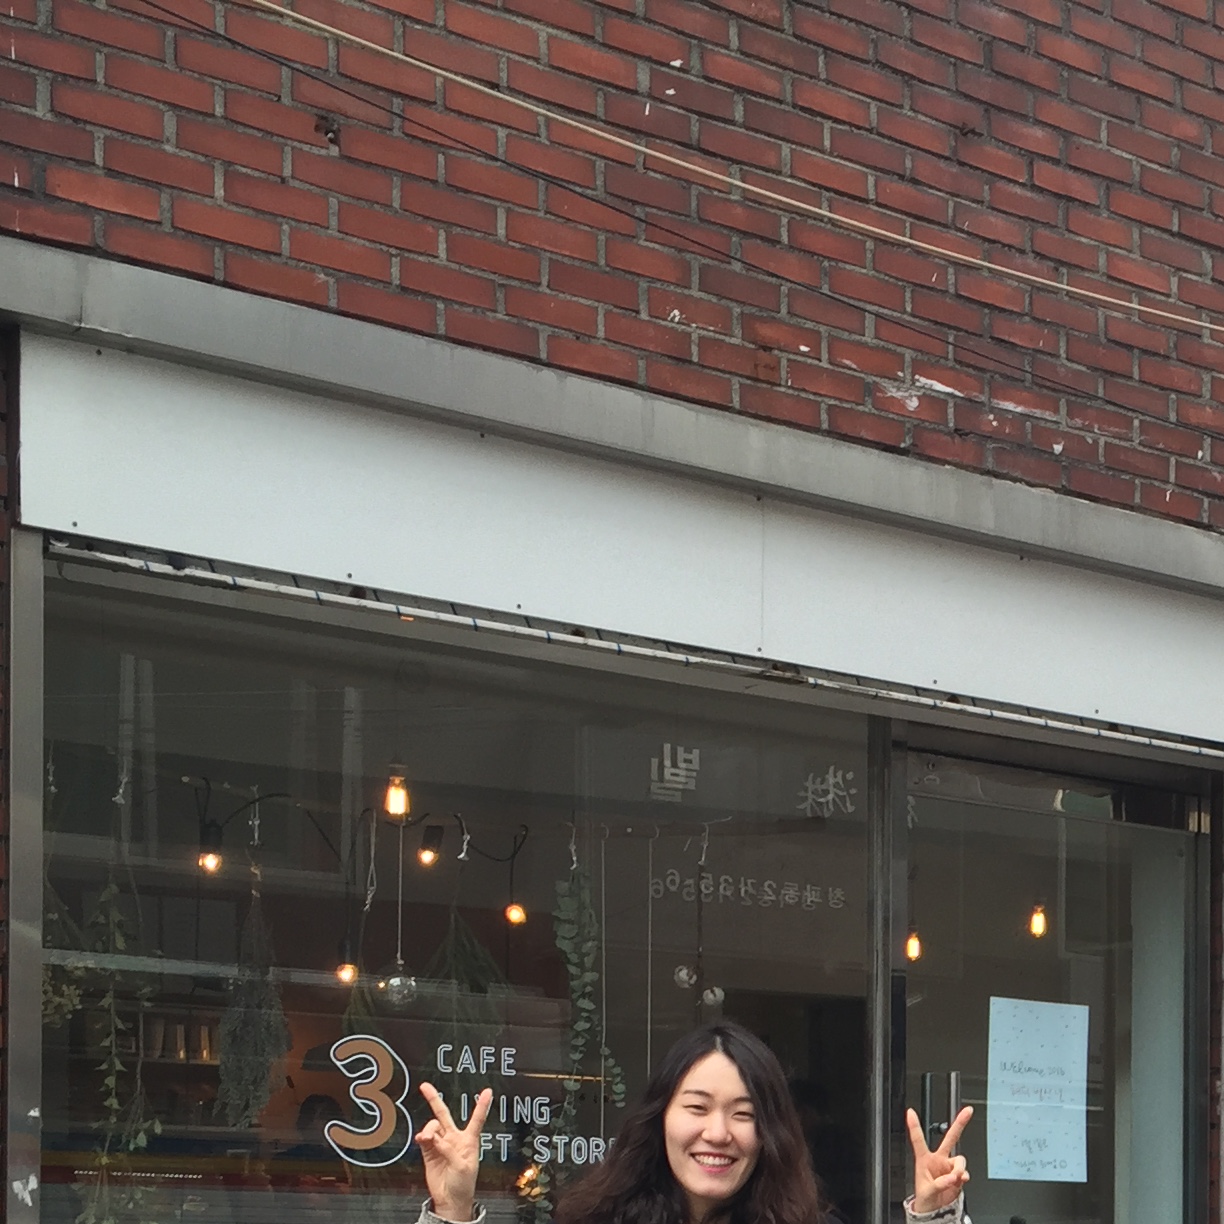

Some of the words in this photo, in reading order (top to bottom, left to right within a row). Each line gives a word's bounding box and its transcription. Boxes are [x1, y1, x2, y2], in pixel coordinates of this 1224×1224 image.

[437, 1044, 517, 1076] CAFE
[324, 1034, 413, 1168] 3
[438, 1092, 550, 1125] IING
[479, 1133, 512, 1162] FT
